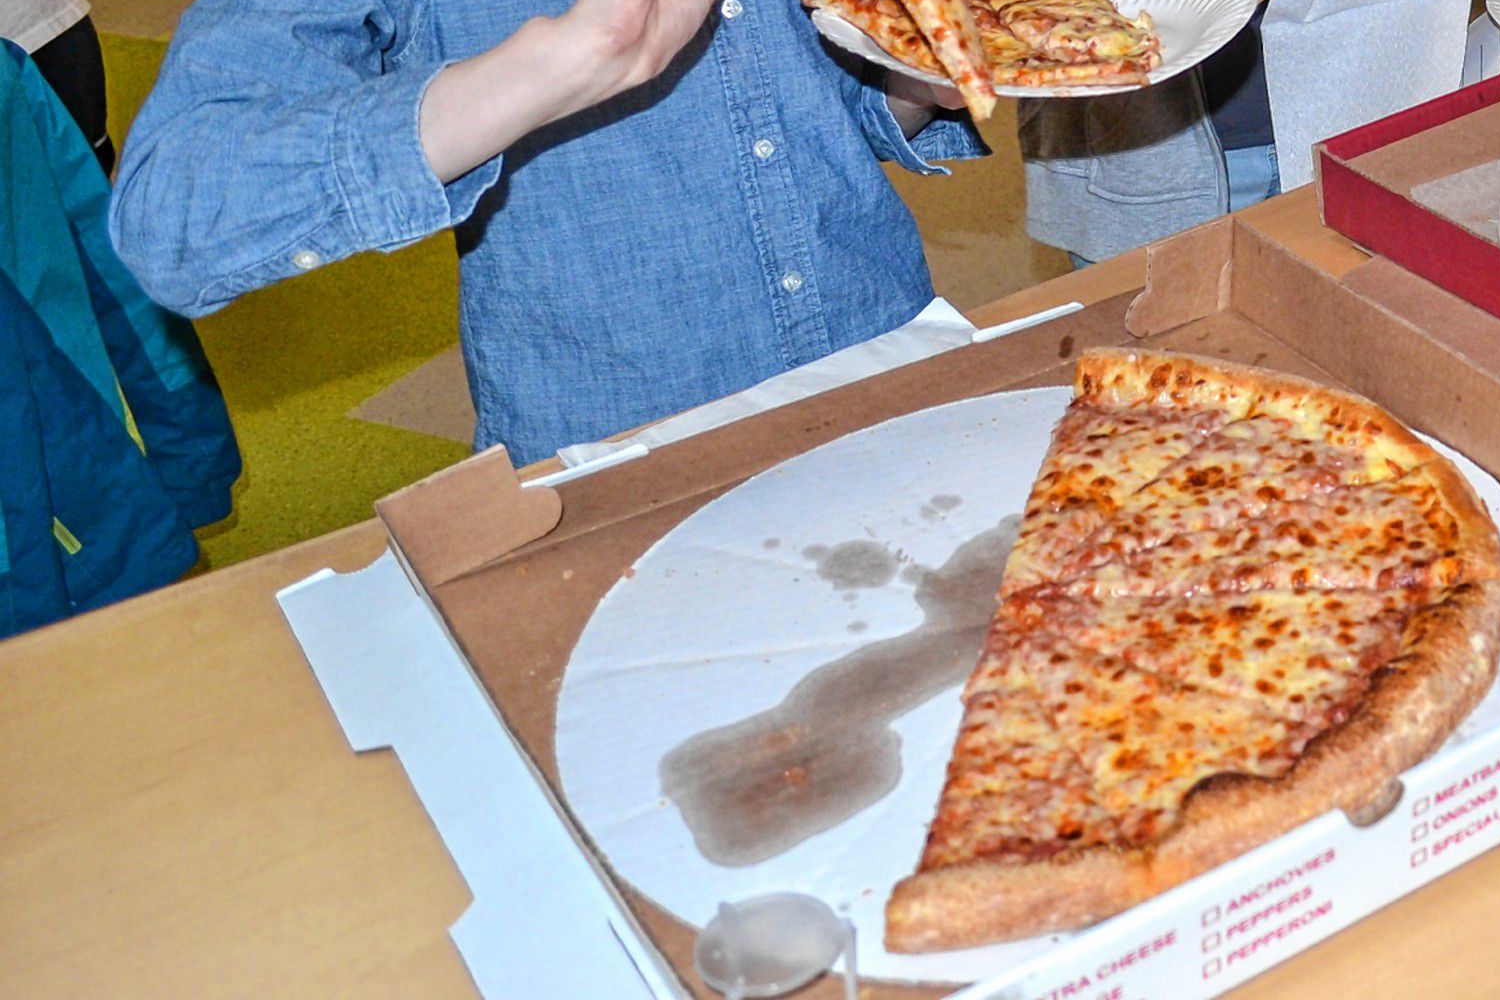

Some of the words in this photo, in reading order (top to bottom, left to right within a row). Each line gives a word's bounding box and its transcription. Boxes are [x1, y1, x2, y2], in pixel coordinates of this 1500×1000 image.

[1432, 786, 1499, 831] ONIONS
[1226, 848, 1336, 914] ANCHOVIES
[1226, 885, 1313, 940] PEPPERS
[1226, 900, 1334, 966] PEPPERONI
[1096, 929, 1177, 981] CHEESE
